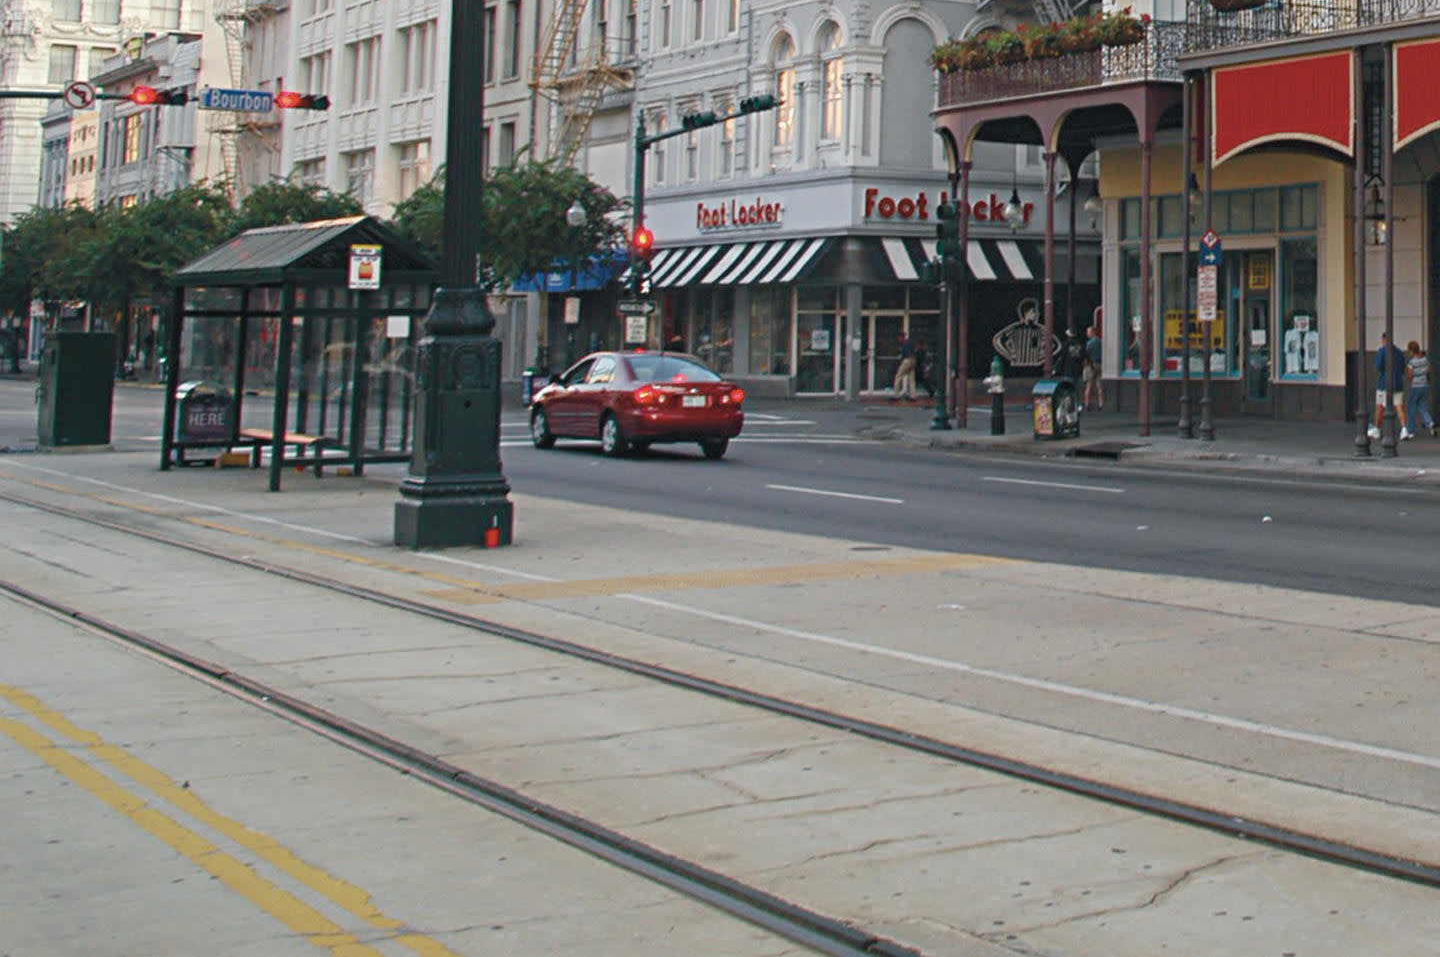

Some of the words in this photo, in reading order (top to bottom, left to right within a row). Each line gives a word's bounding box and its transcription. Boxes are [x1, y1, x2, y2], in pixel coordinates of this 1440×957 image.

[210, 89, 271, 111] Bourbon
[697, 201, 726, 229] Foot
[732, 196, 781, 225] Locker
[865, 188, 929, 220] Foot
[189, 412, 225, 426] HERE
